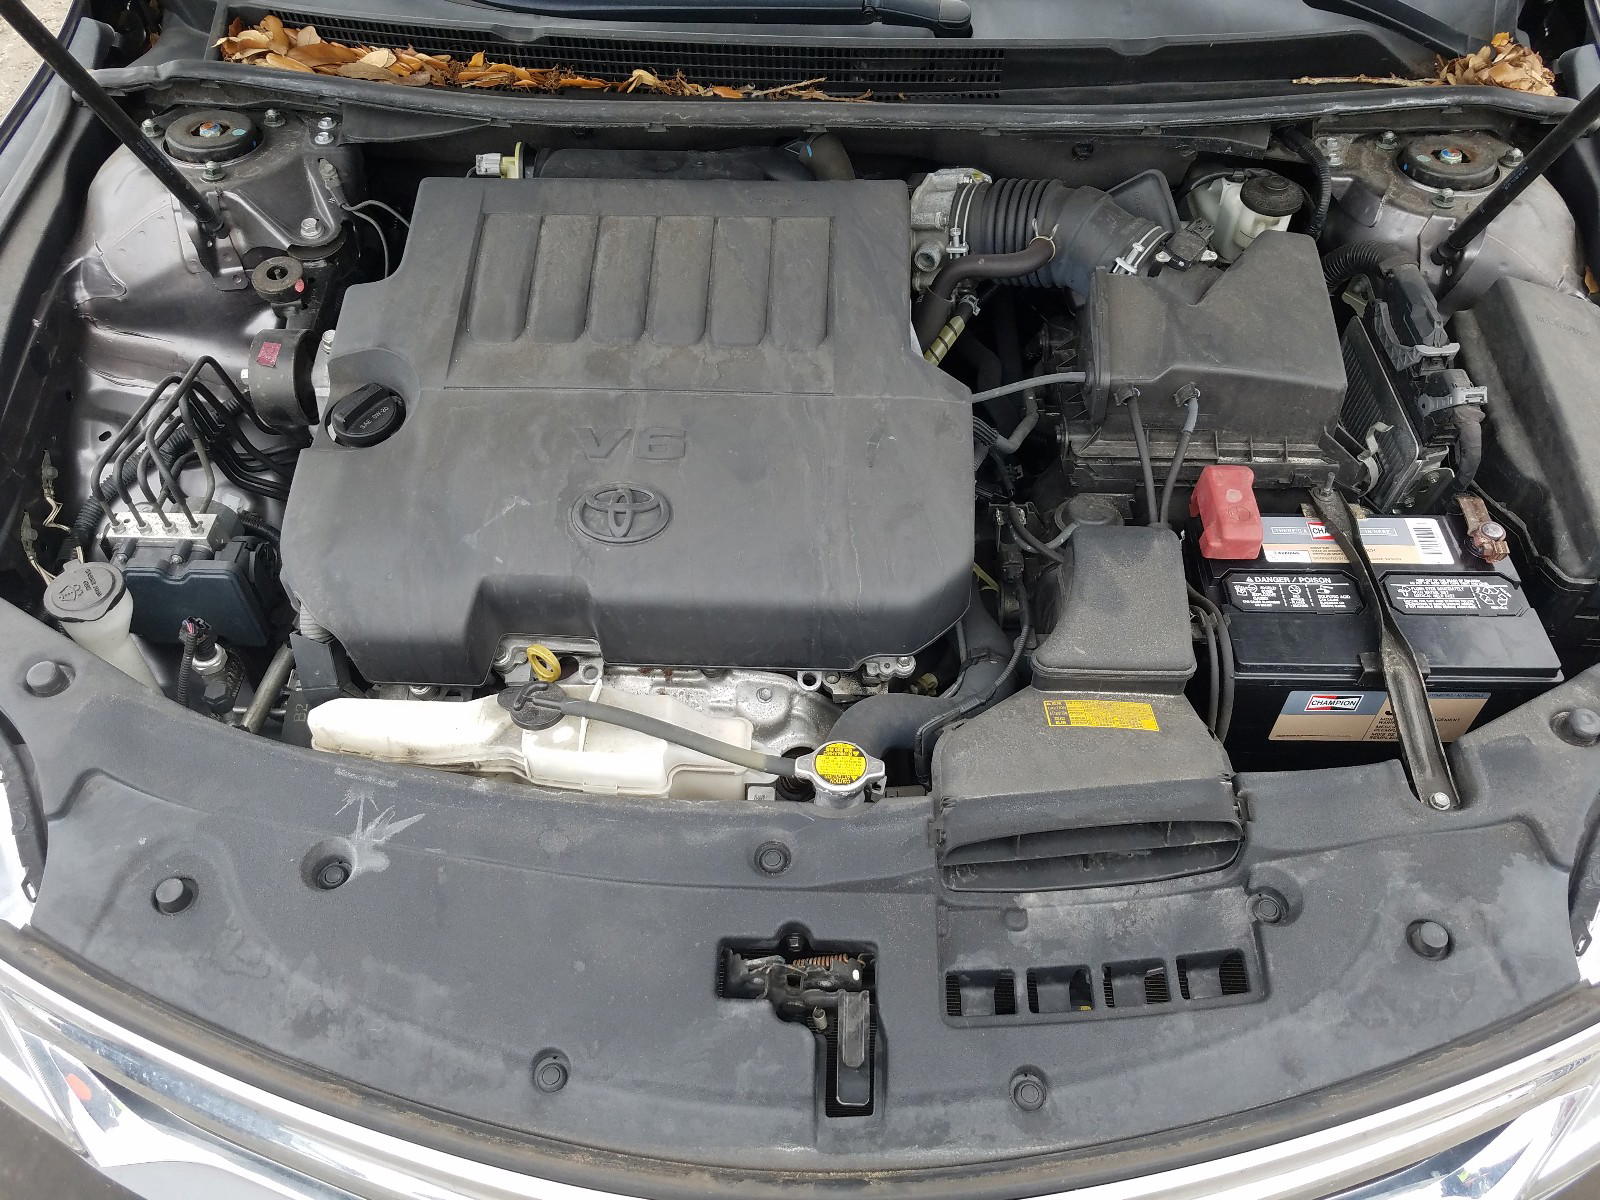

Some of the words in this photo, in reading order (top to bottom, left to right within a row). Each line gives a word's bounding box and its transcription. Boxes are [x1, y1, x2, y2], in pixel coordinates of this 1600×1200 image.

[576, 426, 687, 461] V6
[294, 703, 309, 722] B2
[1311, 699, 1357, 707] CHAMPION
